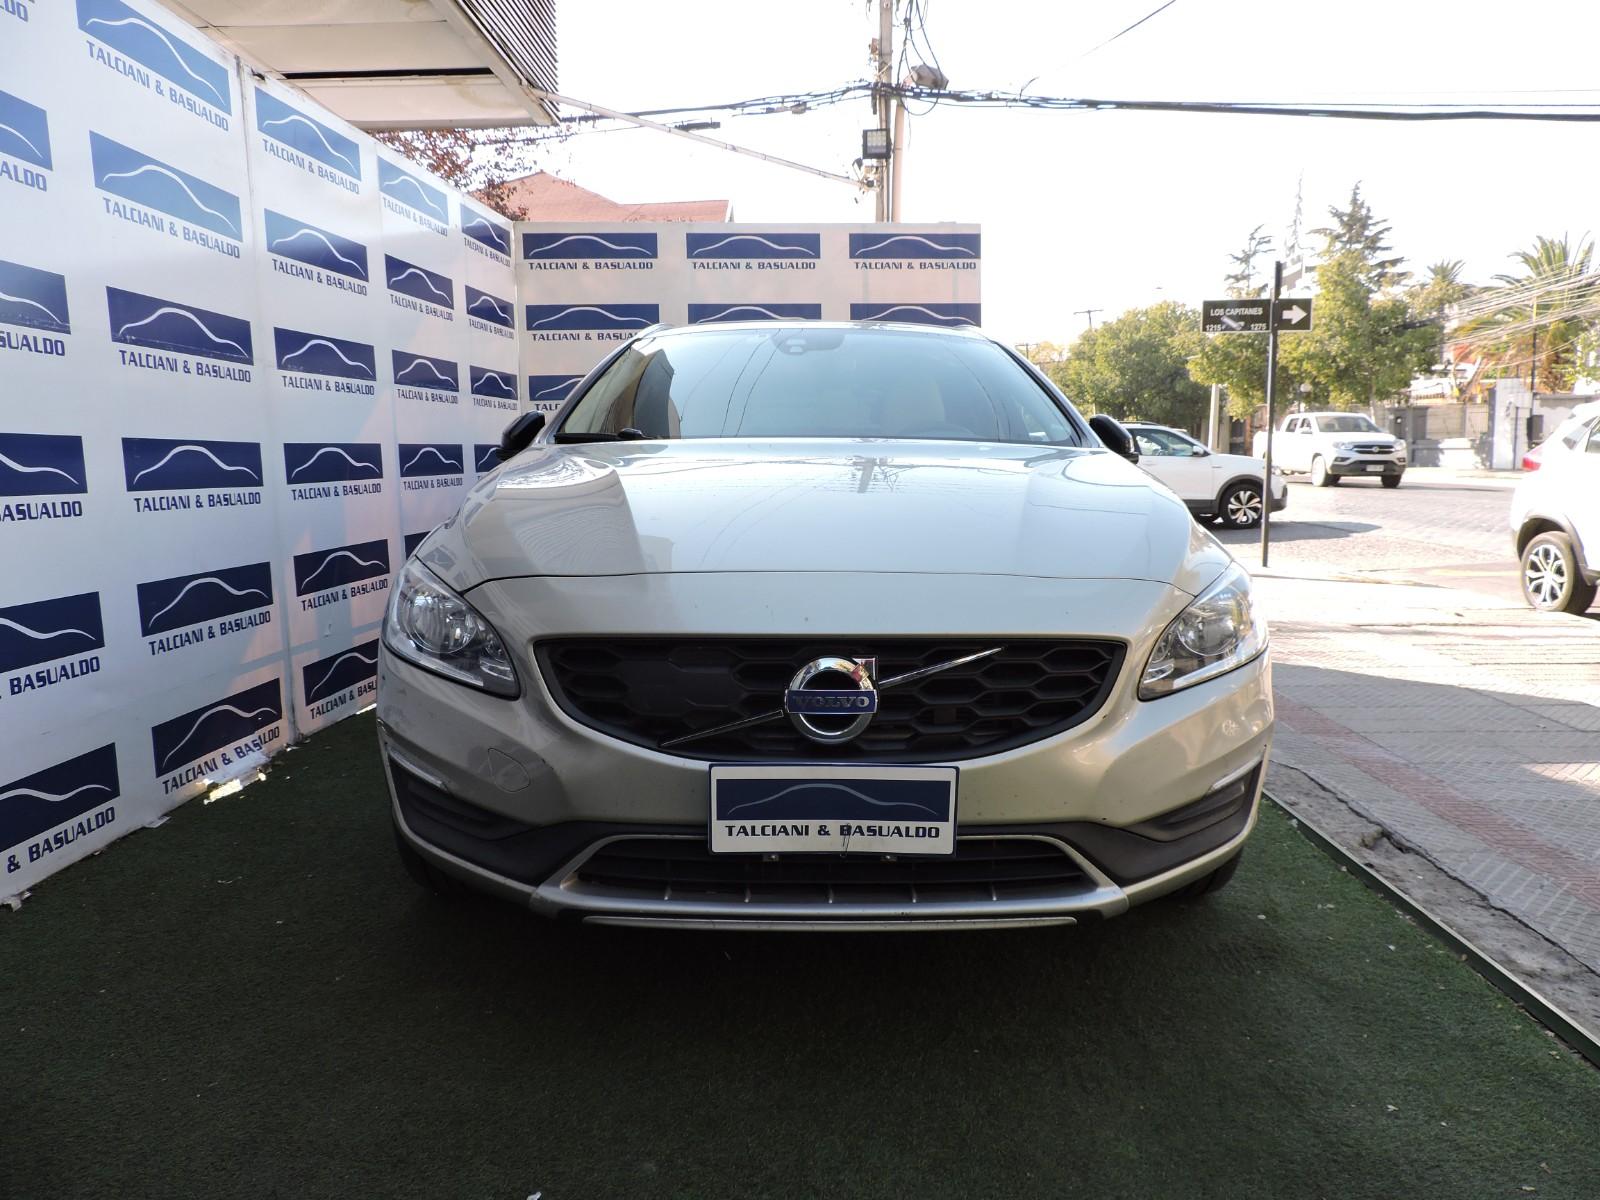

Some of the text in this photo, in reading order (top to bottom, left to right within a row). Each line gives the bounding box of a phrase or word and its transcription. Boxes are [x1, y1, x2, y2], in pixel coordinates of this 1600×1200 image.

[86, 40, 229, 132] TALCIANI & BASUALDO
[0, 160, 47, 192] ALDO
[262, 138, 360, 194] TALCIANI & BASUALDO
[103, 197, 240, 259] TALCIANI & BASUALDO
[272, 259, 368, 296] TALCIANI & BASUALDO
[529, 262, 654, 270] TALCIANI & BASUALDO
[692, 262, 816, 270] TALCIANI & BASUALDO
[854, 262, 976, 270] TALCIANI & BASUALDO
[390, 294, 418, 312] TALCIANI
[426, 305, 453, 321] BASUALDO
[1210, 308, 1263, 316] LOS CAPITANES
[532, 333, 580, 341] TALCIANI
[598, 332, 638, 340] BASUA
[120, 350, 251, 383] TALCIANI & BASUALDO
[282, 376, 374, 395] TALCIANI & BASUALDO
[398, 389, 458, 404] TALCIANI & BASUALDO
[292, 483, 382, 500] TALCIANI & BASUALDO
[404, 480, 428, 490] TALCIANI
[436, 478, 462, 488] BASUALDO
[0, 501, 82, 522] ASUALDO
[134, 492, 261, 512] TALCIANI & BASUALDO
[301, 578, 388, 612] TALCIANI & BASUALDO
[148, 610, 271, 656] TALCIANI & BASUALDO
[9, 656, 100, 696] BASUALDO
[310, 696, 346, 720] TALCIANI
[162, 758, 218, 794] TALCIANI
[222, 752, 232, 766] &
[7, 806, 116, 873] & BASUALDO
[725, 824, 940, 838] TALCIANI & BASUALDO
